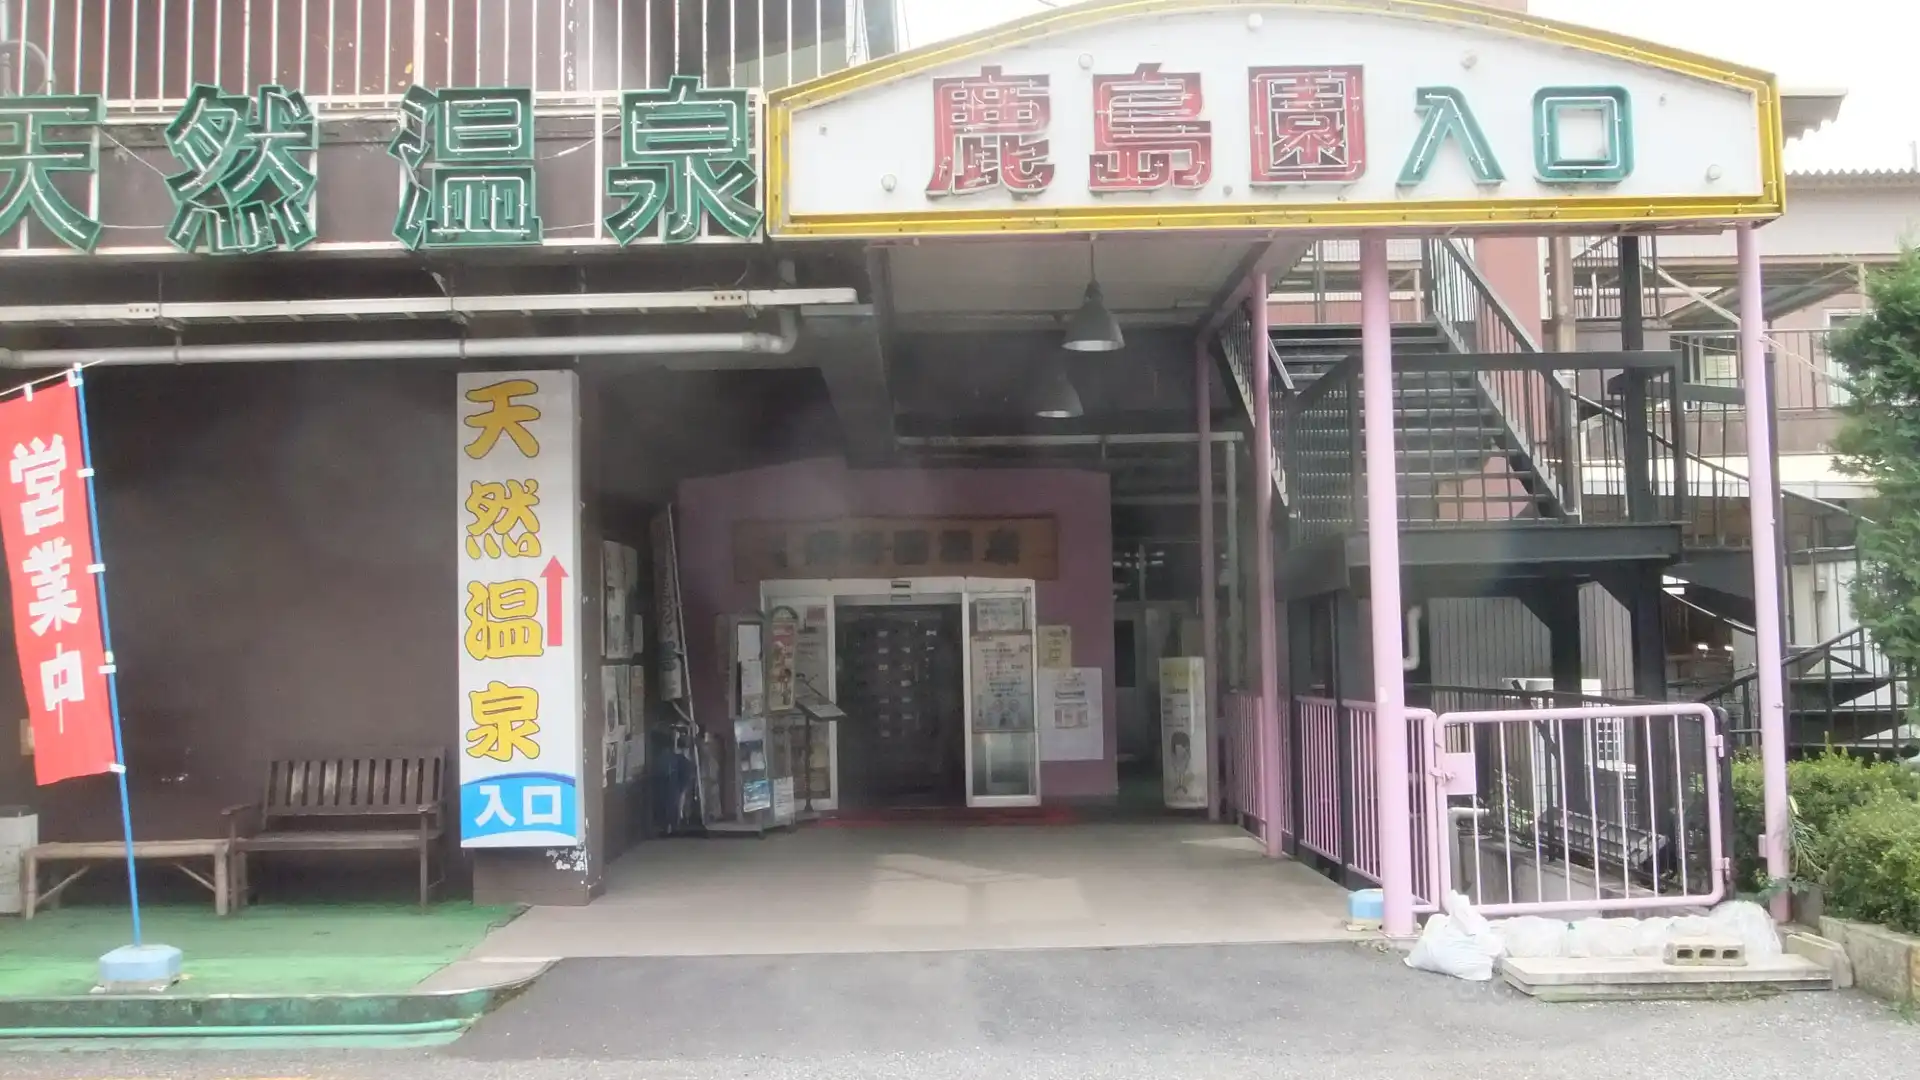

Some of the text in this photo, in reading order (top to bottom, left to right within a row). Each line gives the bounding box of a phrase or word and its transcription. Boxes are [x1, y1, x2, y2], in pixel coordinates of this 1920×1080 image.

[0, 75, 763, 254] 天然温泉
[10, 434, 85, 734] 営業中
[464, 379, 544, 763] 天然温泉
[475, 785, 562, 828] 入口
